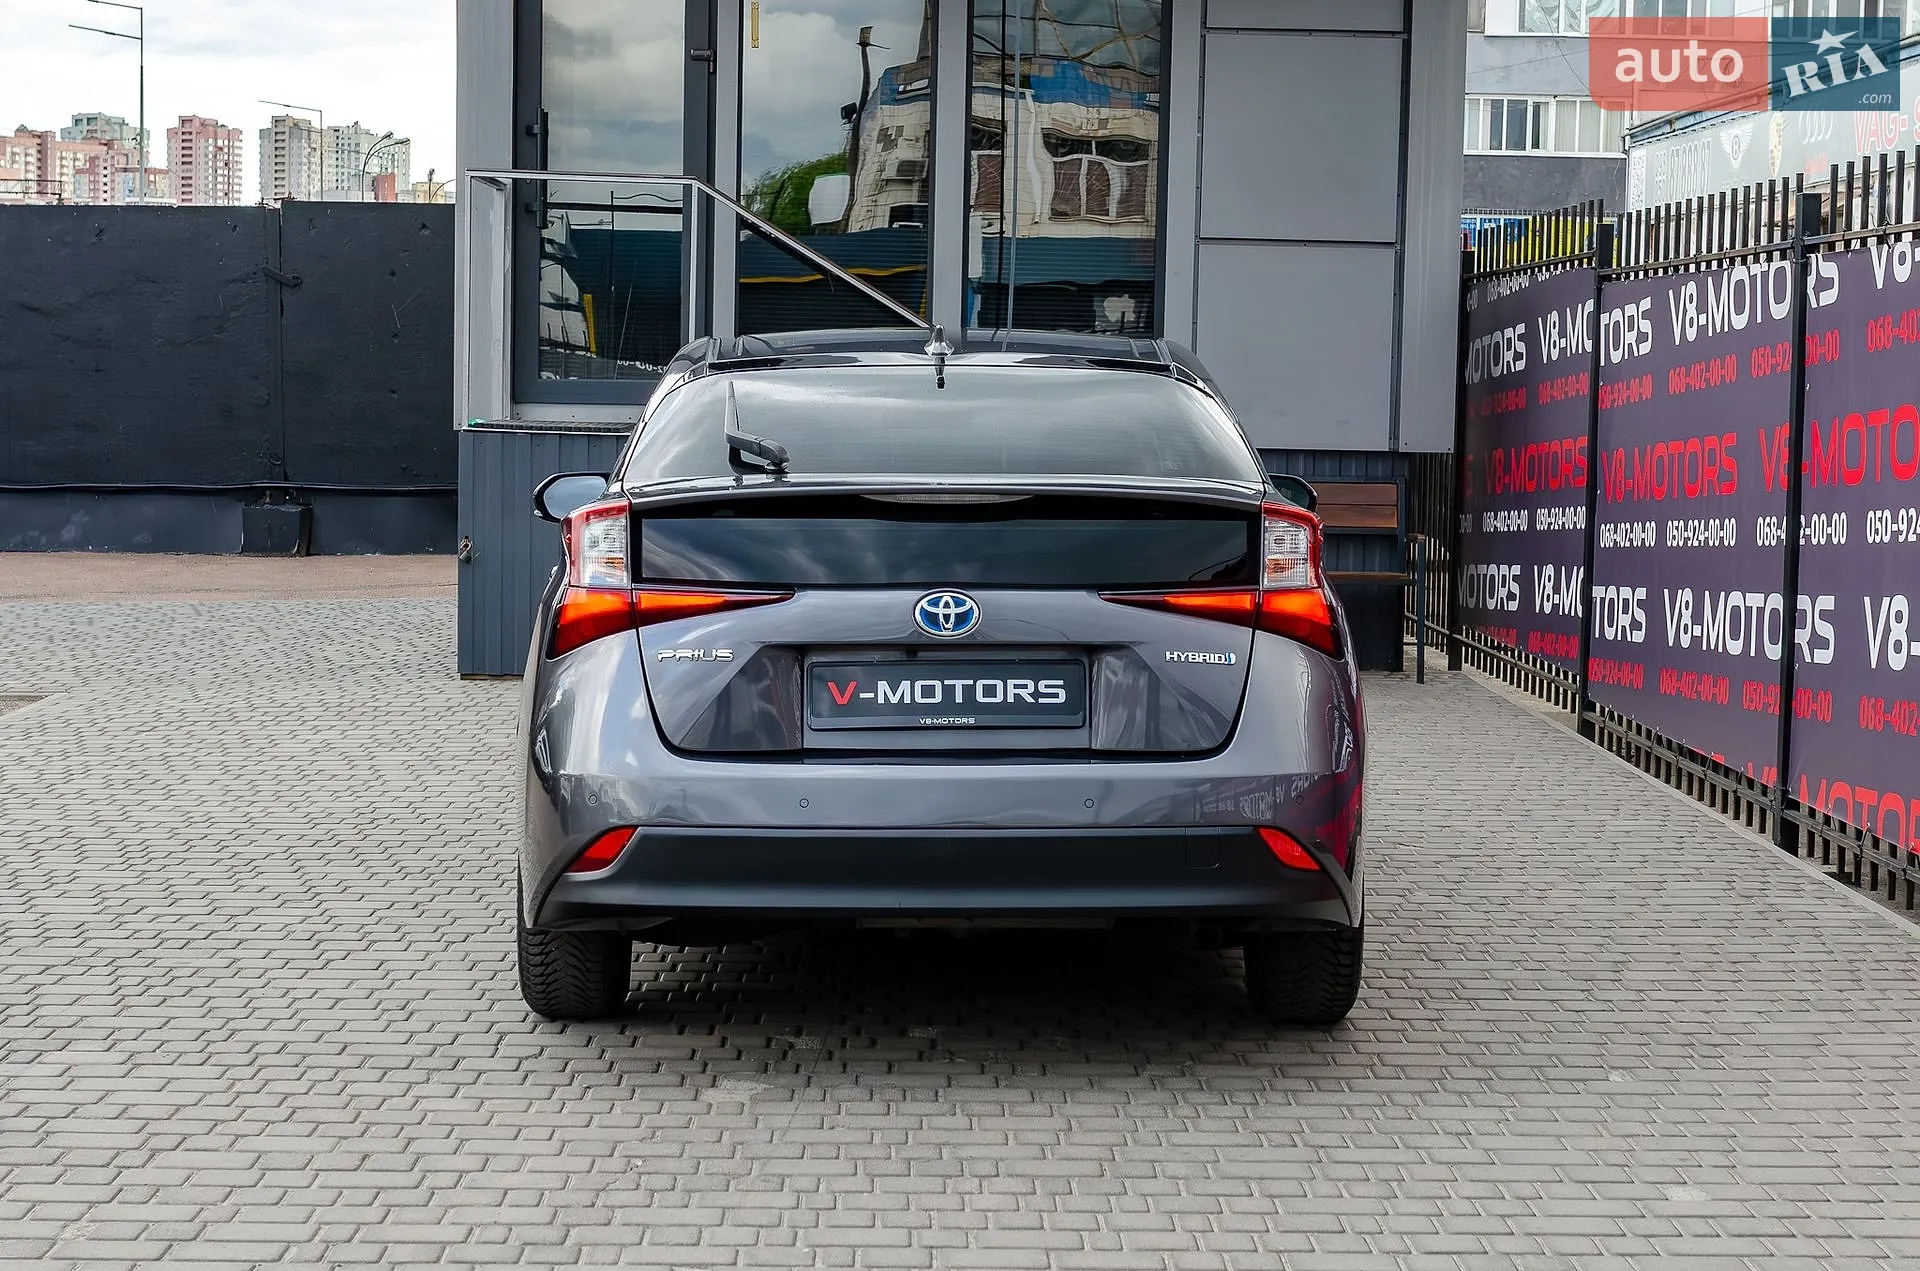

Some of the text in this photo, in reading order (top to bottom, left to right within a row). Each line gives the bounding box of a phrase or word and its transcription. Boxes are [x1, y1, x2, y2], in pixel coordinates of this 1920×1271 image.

[1668, 353, 1737, 395] 068-402-00-00
[1485, 435, 1588, 495] V8-MOTORS
[1601, 432, 1738, 504] V8-MOTORS
[1482, 509, 1528, 532] 068-402-00-00
[1536, 505, 1586, 531] 050-924-00-00
[1599, 520, 1656, 548] 068-402-00-00
[1666, 517, 1737, 547] 050-924-00-00
[1756, 511, 1848, 547] 068-42-00-00
[657, 647, 734, 662] PRIUS
[1165, 650, 1226, 665] HYBRID
[827, 679, 1067, 705] V-MOTORS
[1660, 666, 1729, 705] 068-402-00-00
[919, 716, 976, 725] V8-MOTORS
